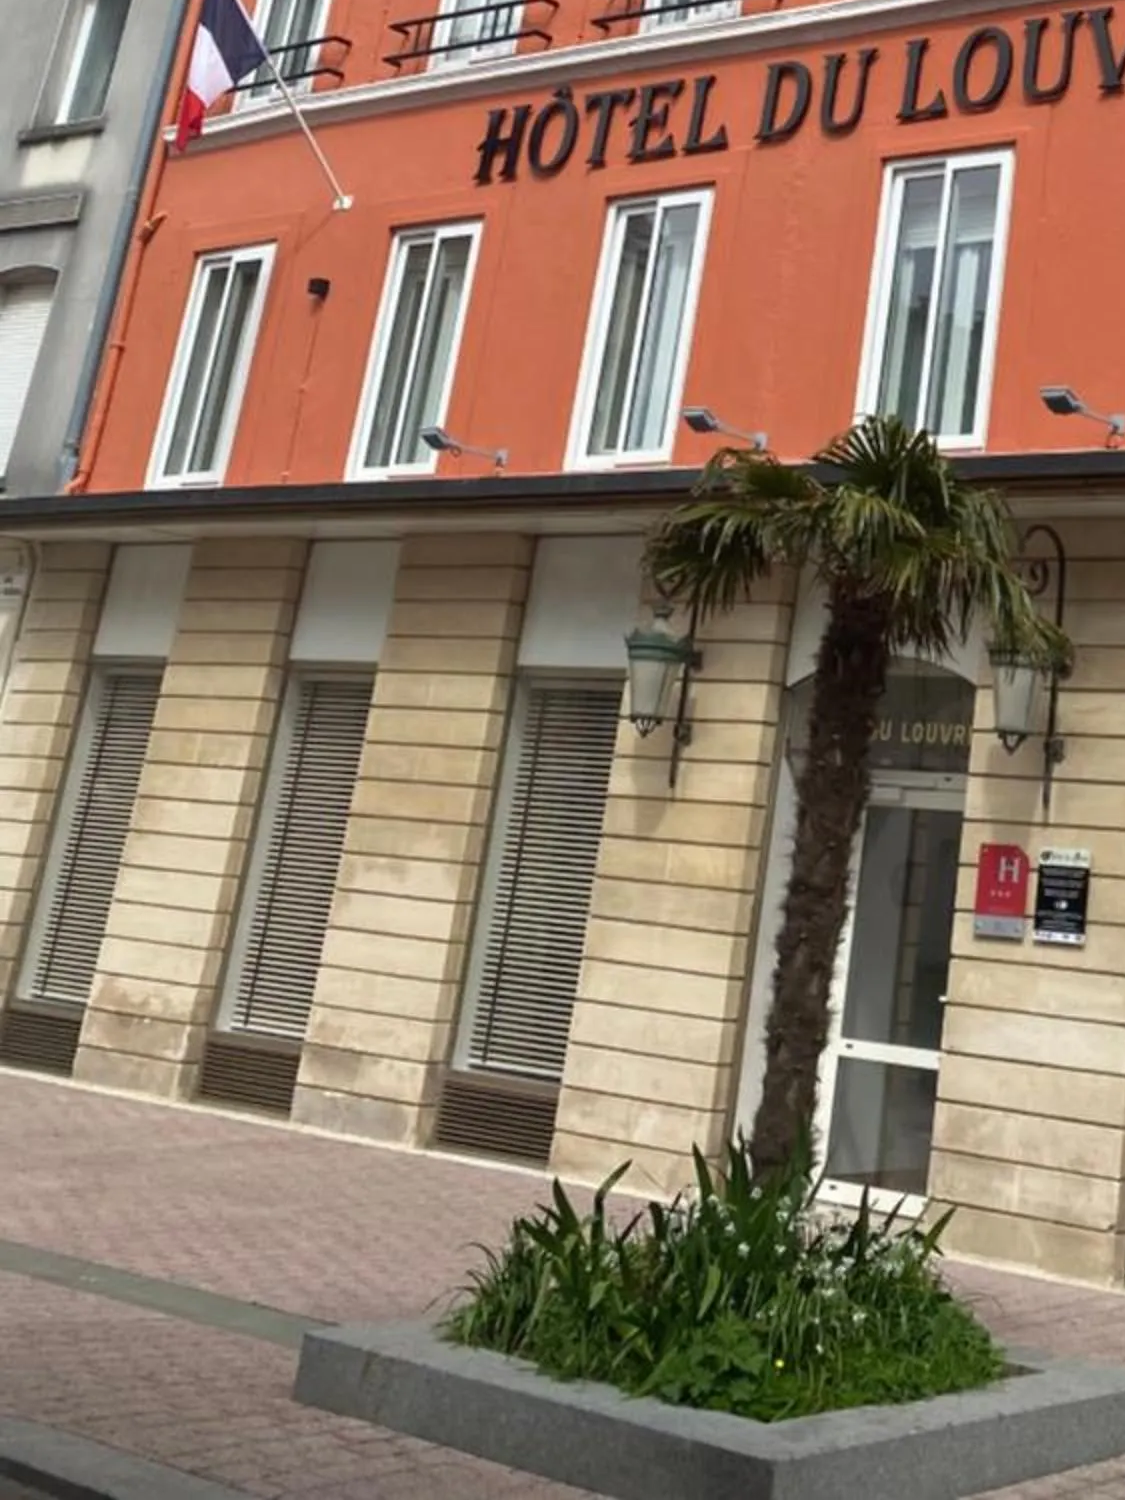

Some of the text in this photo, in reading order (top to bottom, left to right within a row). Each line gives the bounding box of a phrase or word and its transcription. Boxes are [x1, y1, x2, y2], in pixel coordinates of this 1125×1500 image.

[474, 75, 728, 186] HÔTEL
[754, 47, 879, 144] DU
[998, 857, 1020, 883] H
